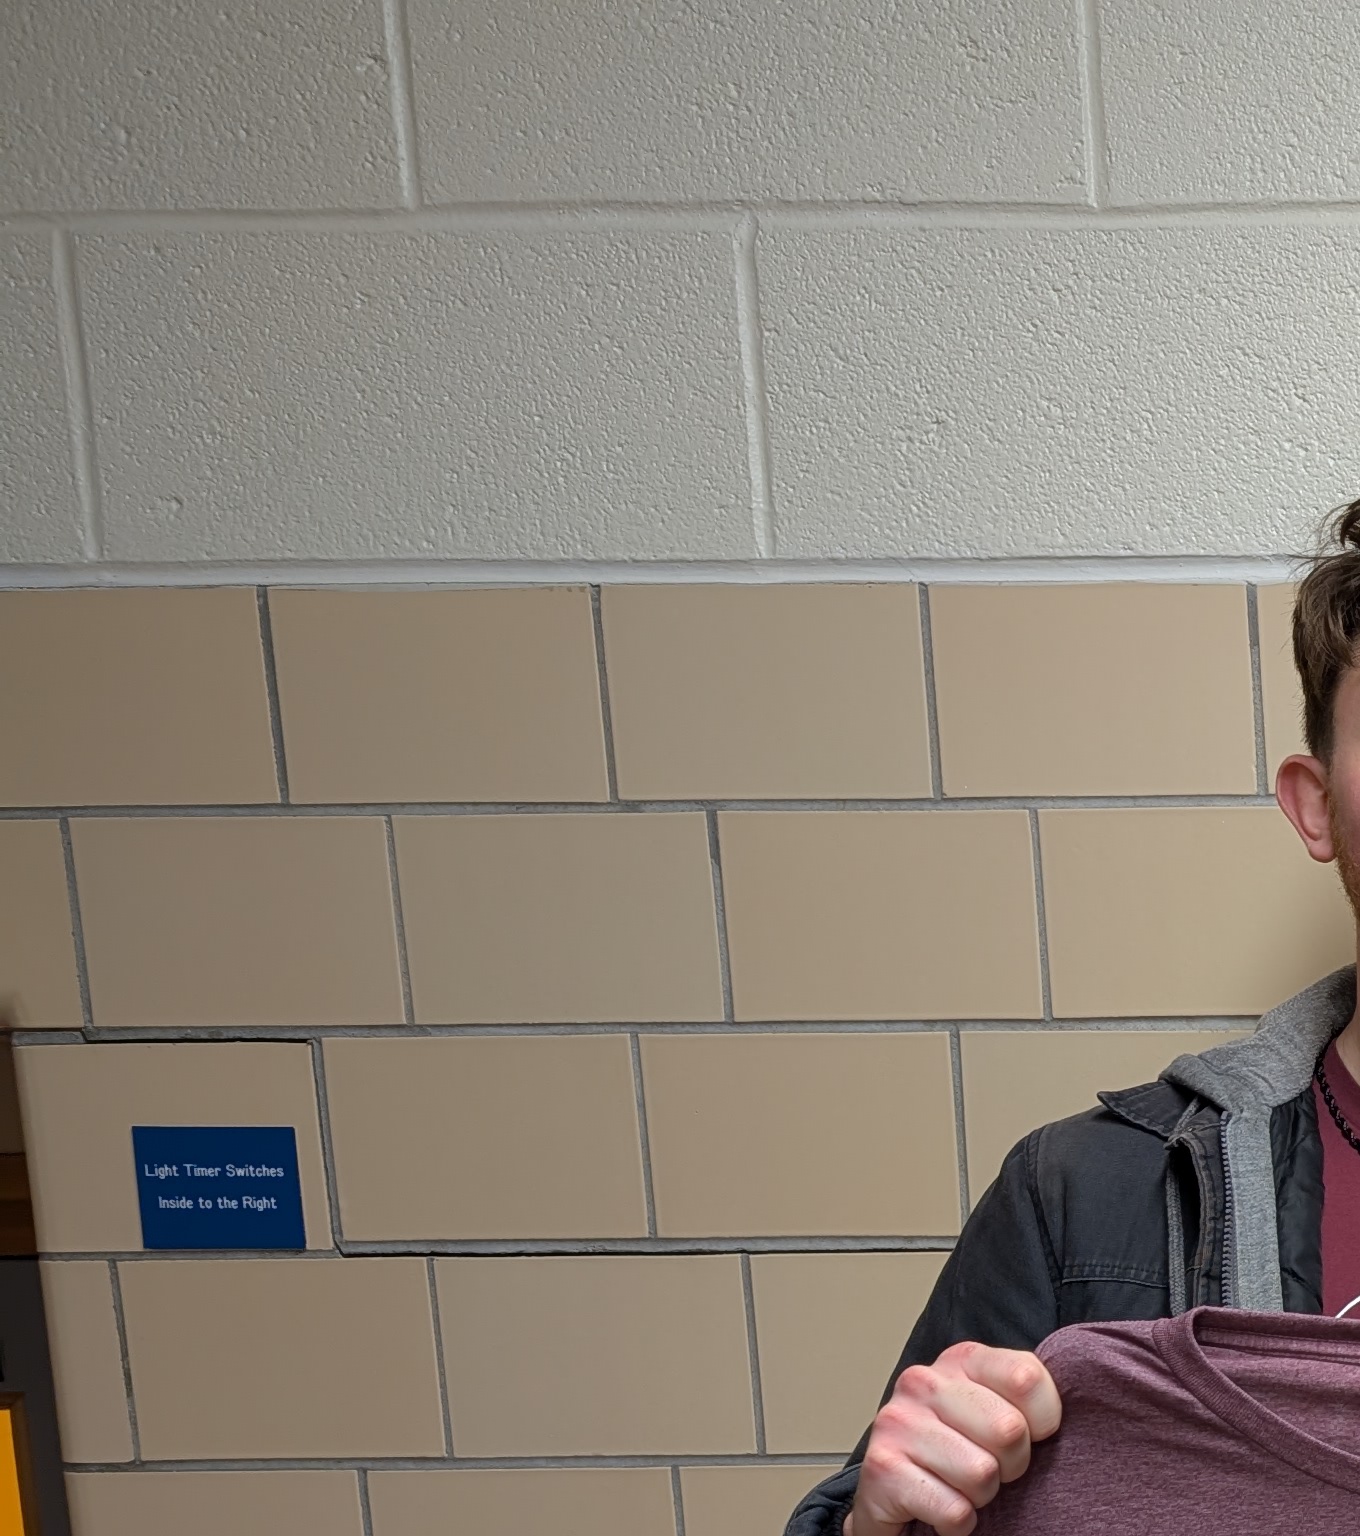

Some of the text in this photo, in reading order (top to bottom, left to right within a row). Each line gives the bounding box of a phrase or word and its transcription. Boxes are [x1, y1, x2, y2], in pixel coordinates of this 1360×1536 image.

[144, 1163, 285, 1180] Light Timer Switches
[158, 1196, 278, 1212] Inside to the Right
